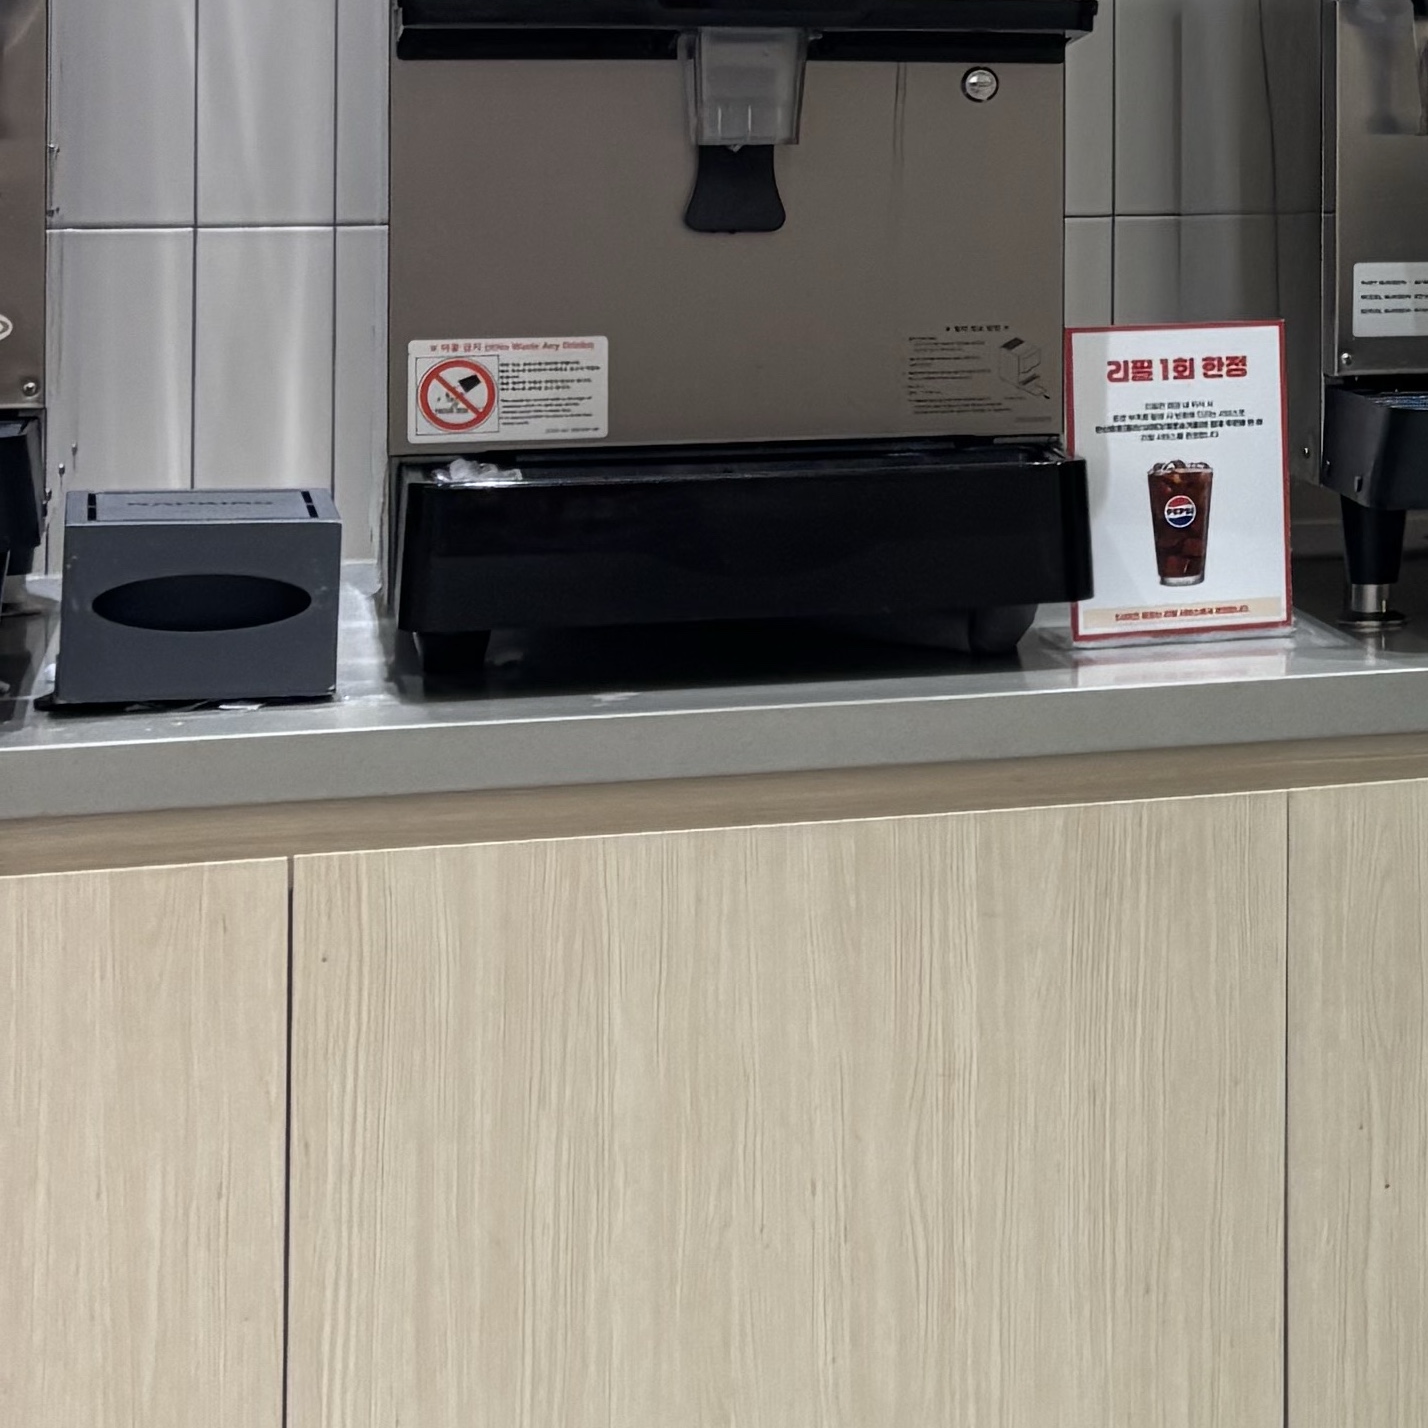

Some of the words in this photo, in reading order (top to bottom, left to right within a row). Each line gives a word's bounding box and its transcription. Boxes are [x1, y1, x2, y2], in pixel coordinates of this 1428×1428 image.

[1106, 359, 1154, 383] 리필
[1159, 357, 1195, 381] 1회
[1201, 355, 1248, 379] 한정
